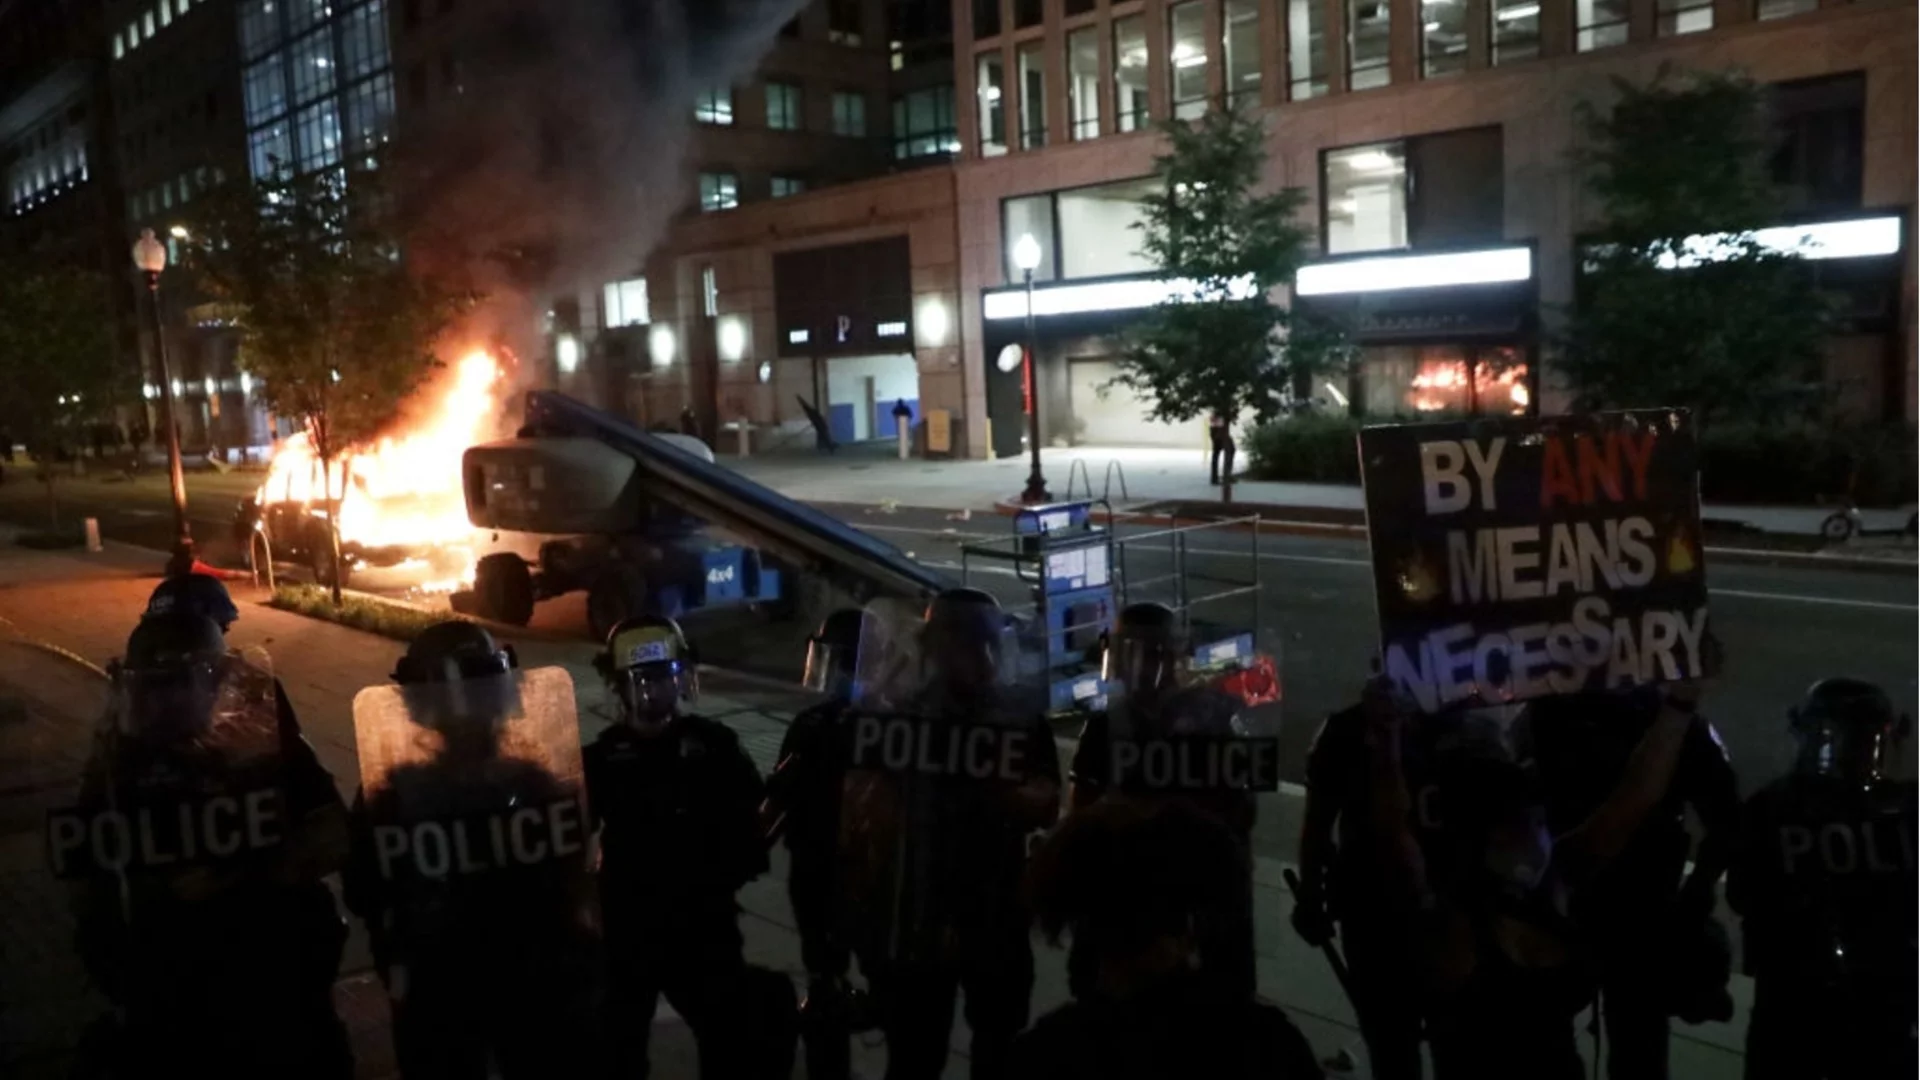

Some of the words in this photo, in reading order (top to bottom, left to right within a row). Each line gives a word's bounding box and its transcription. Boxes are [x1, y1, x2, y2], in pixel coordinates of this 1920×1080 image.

[837, 315, 850, 342] P
[1419, 436, 1506, 515] BY
[1540, 430, 1657, 506] ANY
[706, 564, 735, 584] 4x4
[1446, 515, 1657, 604] MEANS
[1384, 595, 1708, 714] NECESSARY
[850, 715, 1029, 781] POLICE
[1110, 740, 1273, 790] POLICE
[48, 788, 283, 879] POLICE
[372, 799, 582, 882] POLICE
